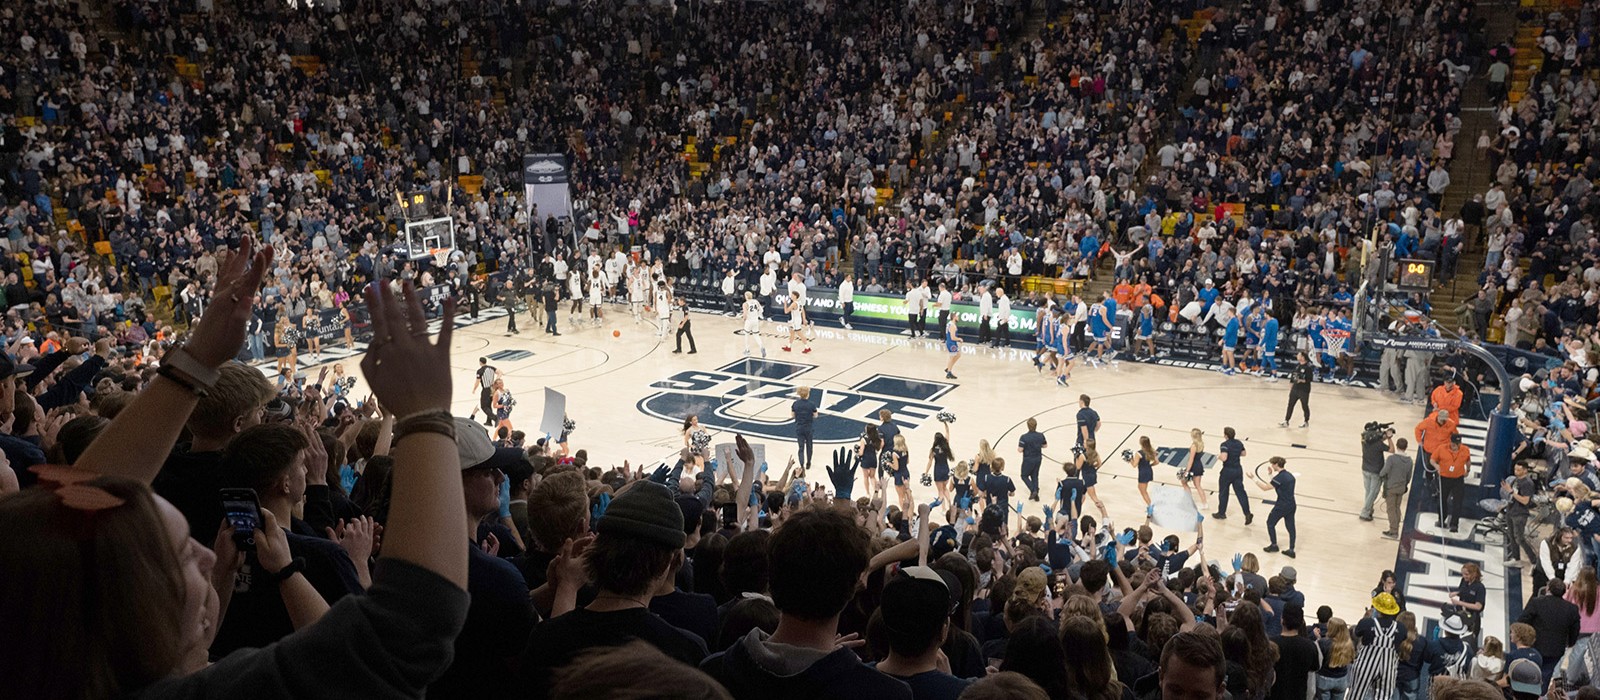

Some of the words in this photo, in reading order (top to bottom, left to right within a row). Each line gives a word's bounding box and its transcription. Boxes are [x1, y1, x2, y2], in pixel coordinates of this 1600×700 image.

[814, 298, 834, 308] AND
[835, 300, 888, 313] FSHNESS
[961, 312, 977, 322] ON
[649, 370, 946, 429] STATE
